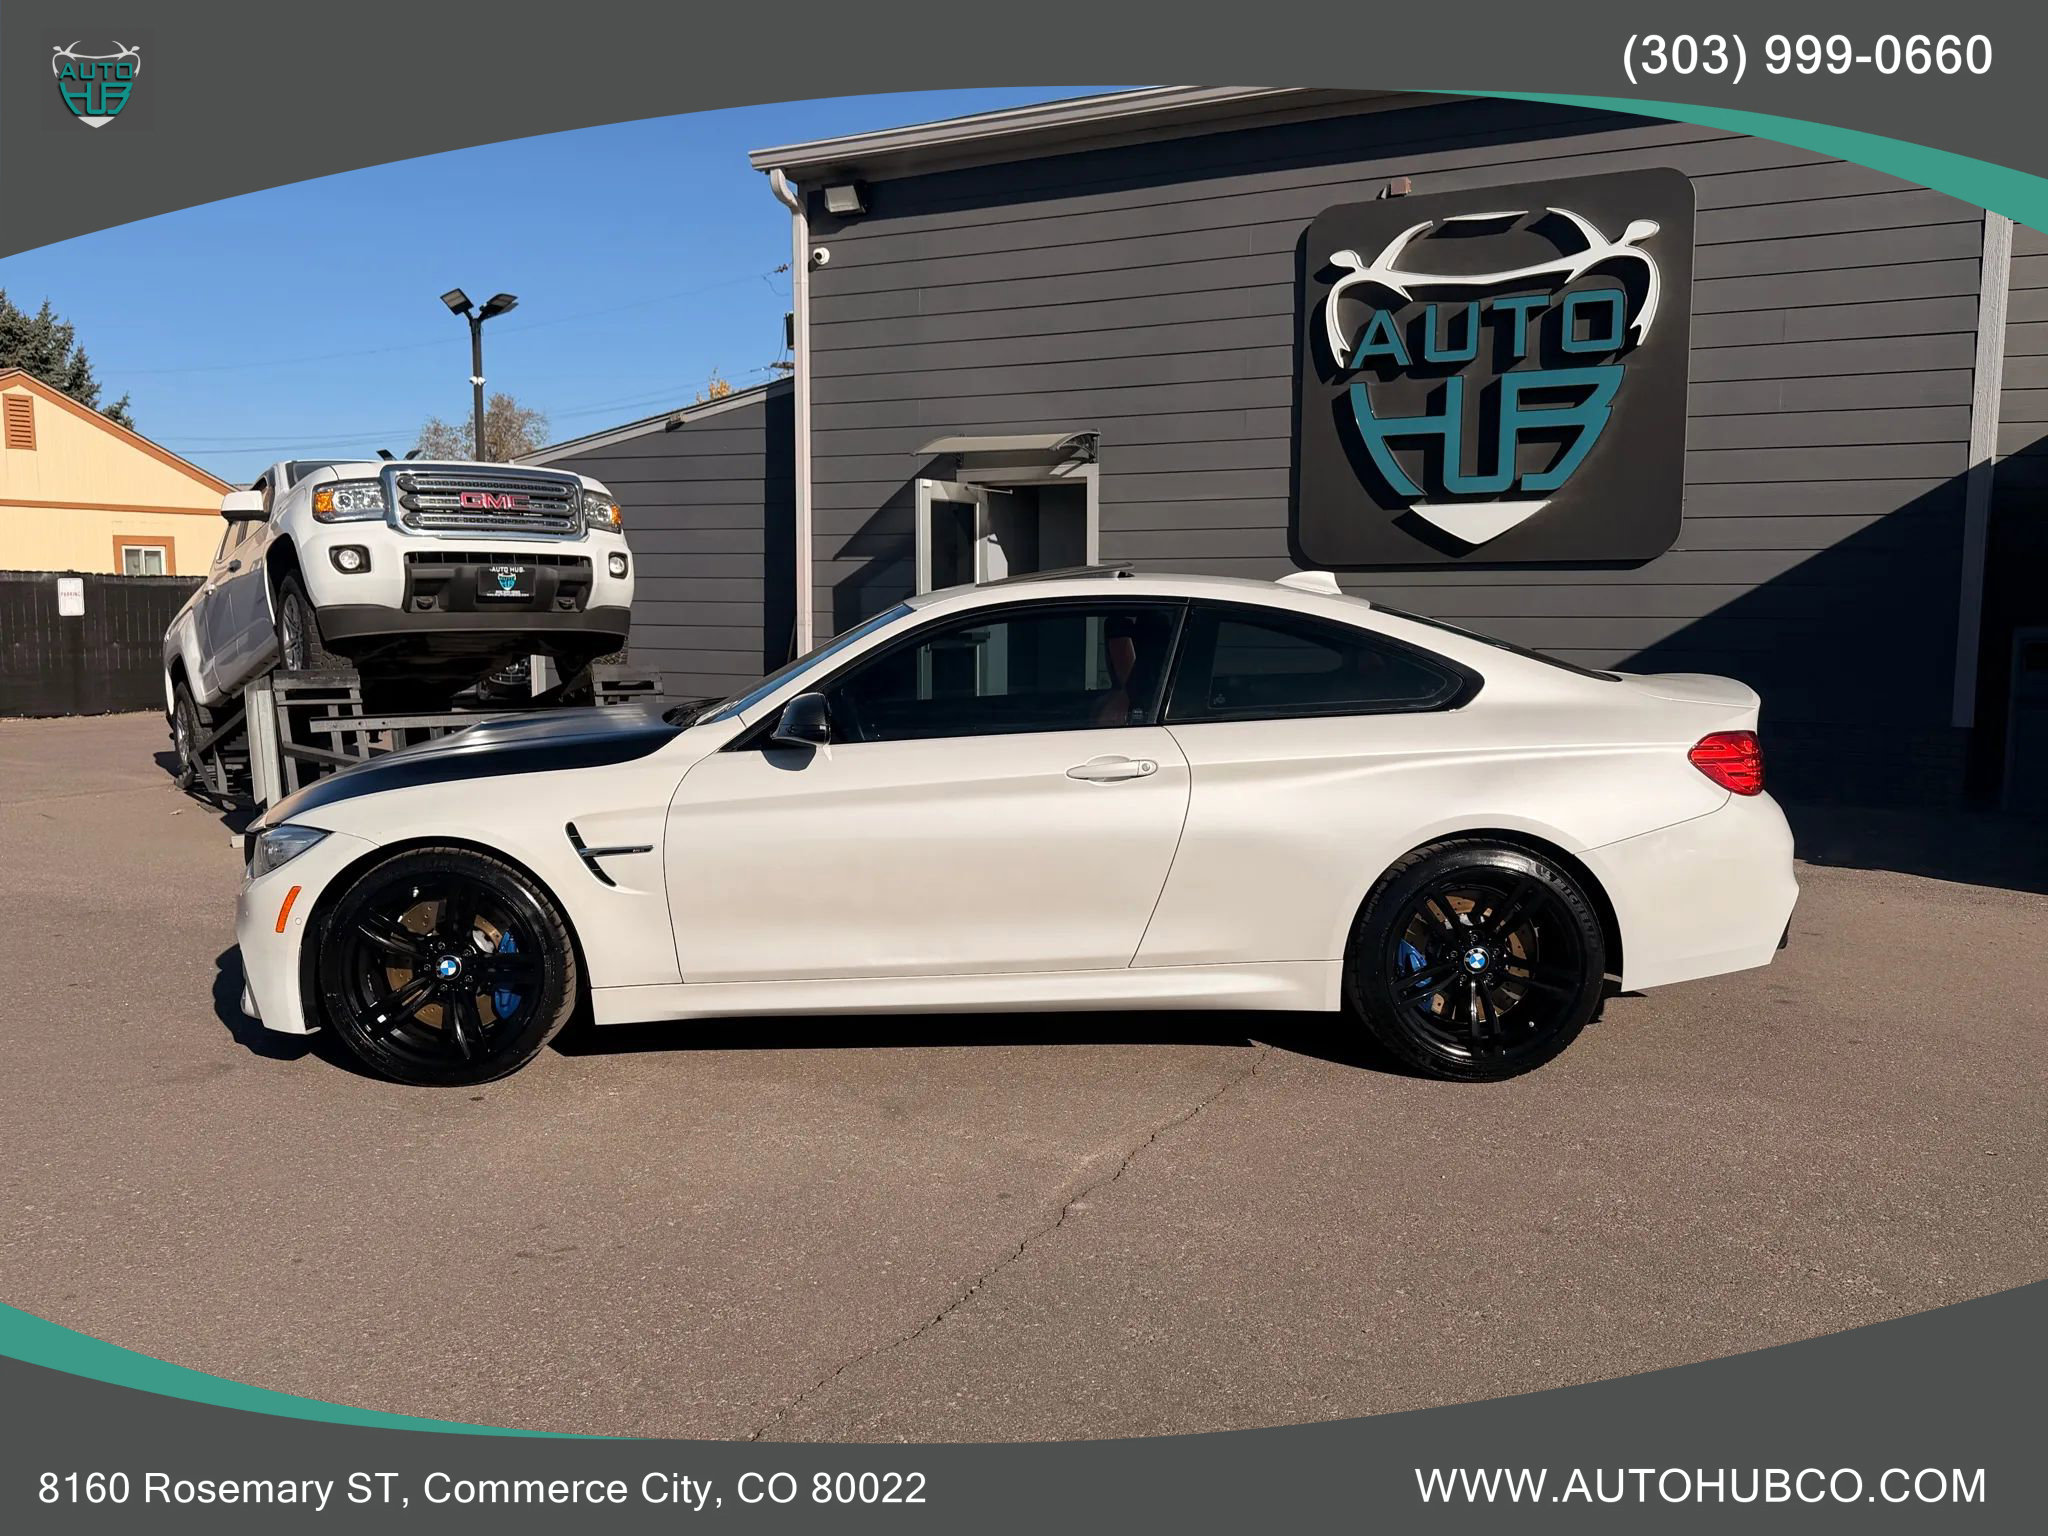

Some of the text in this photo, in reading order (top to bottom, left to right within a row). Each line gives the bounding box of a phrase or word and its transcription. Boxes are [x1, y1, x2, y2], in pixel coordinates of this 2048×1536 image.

[1350, 288, 1624, 369] AUTO
[1350, 364, 1625, 495] HUB
[460, 492, 530, 510] GMC
